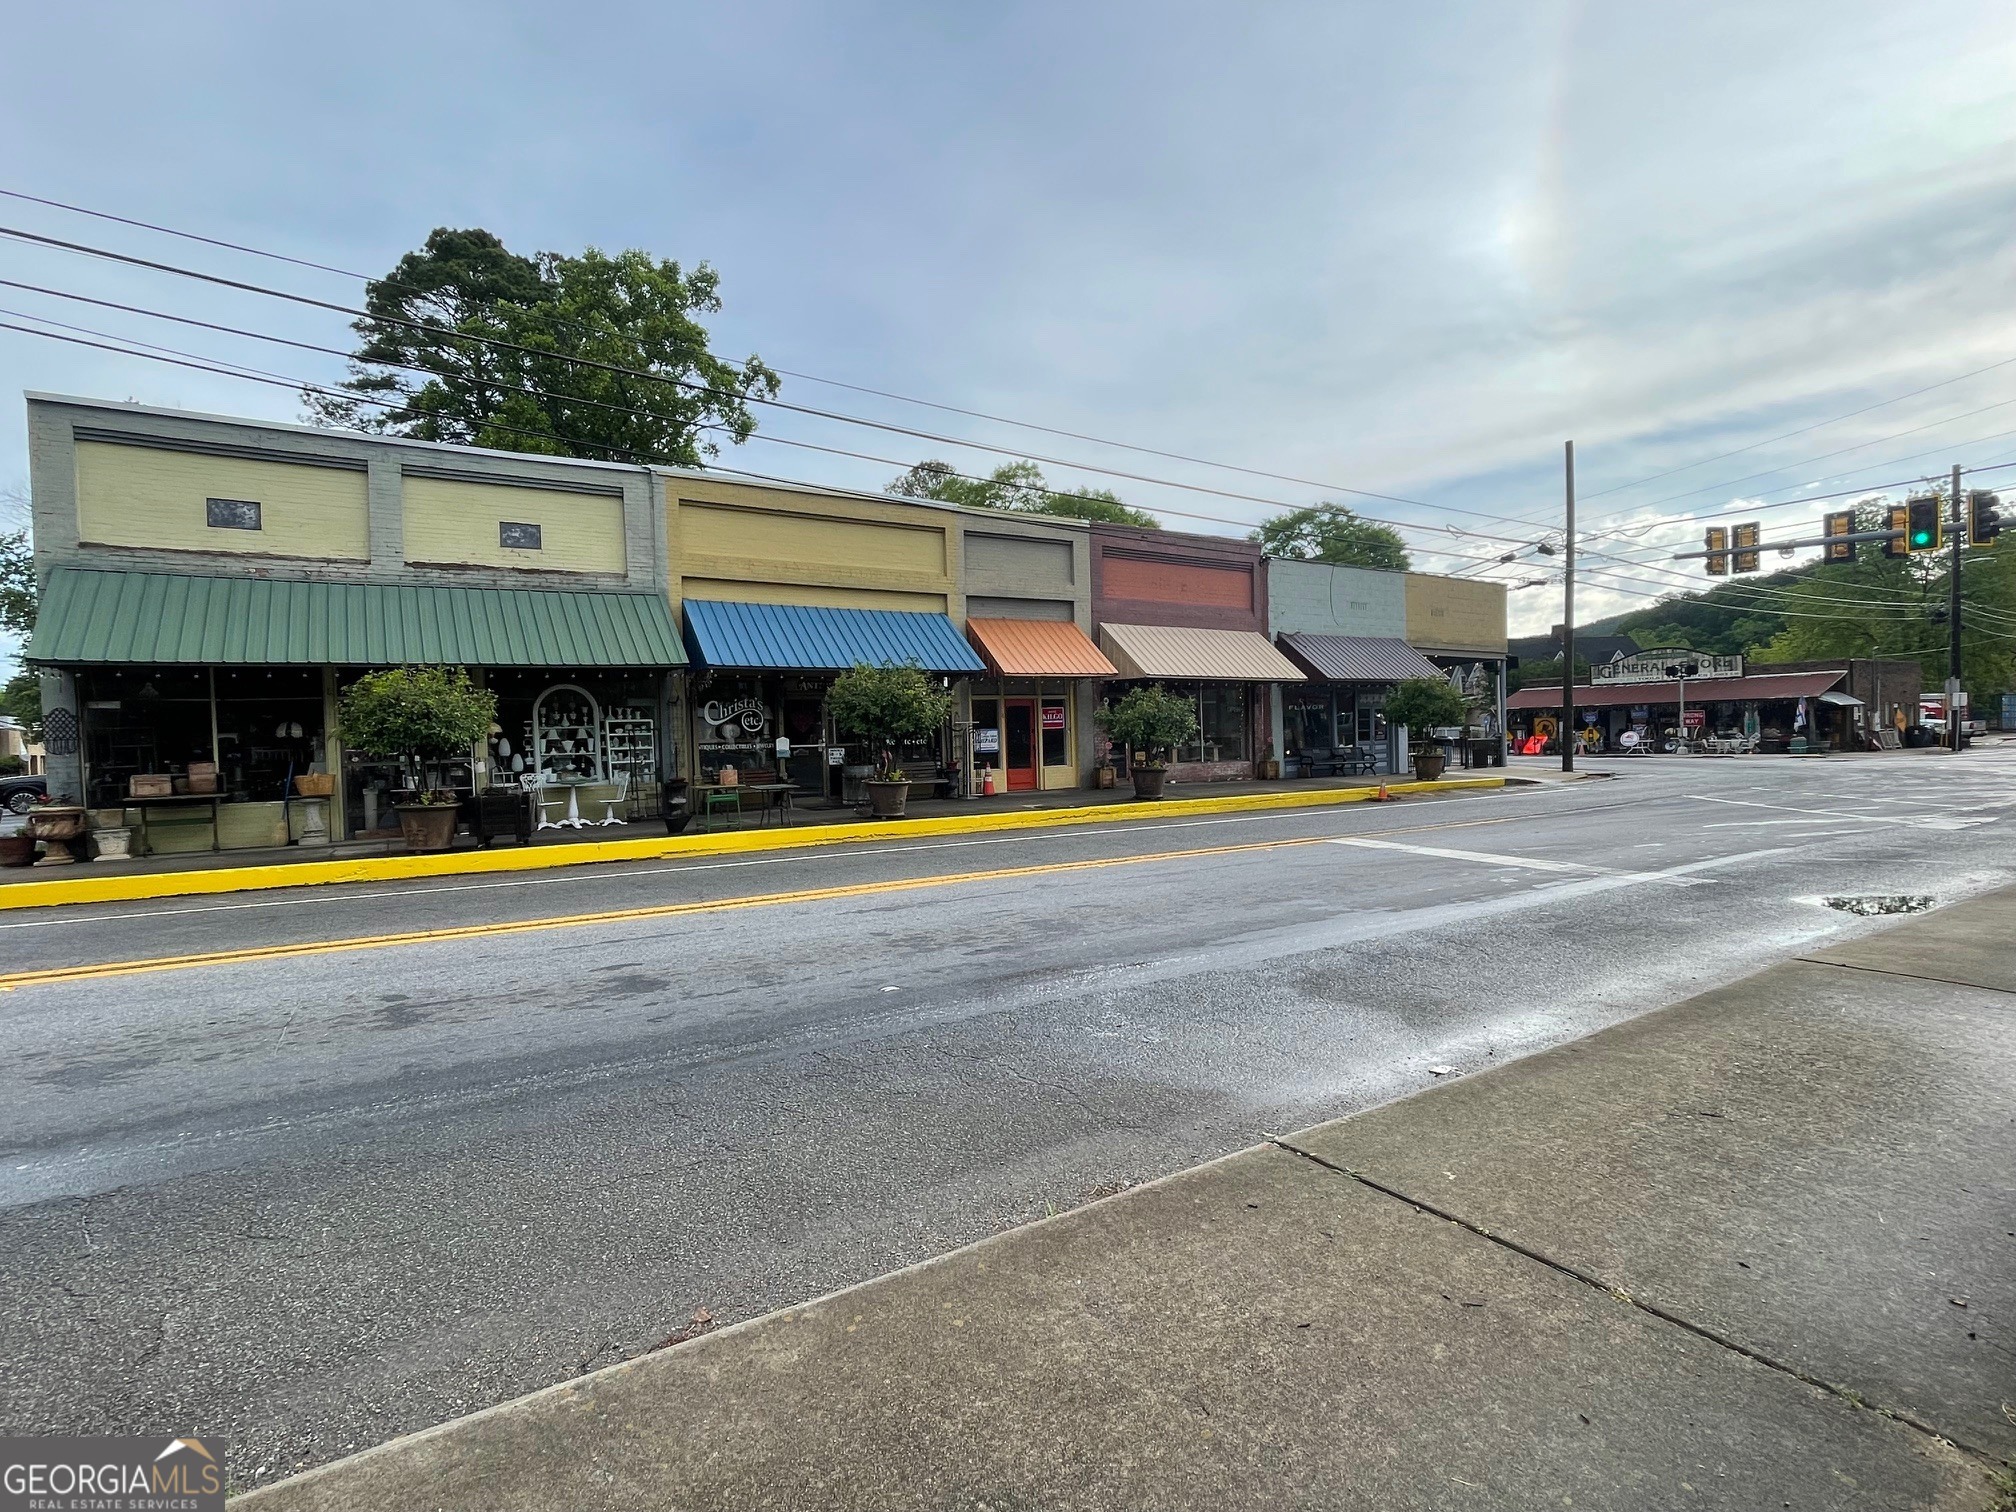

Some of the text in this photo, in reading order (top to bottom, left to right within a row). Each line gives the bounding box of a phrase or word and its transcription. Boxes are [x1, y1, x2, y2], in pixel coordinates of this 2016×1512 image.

[1600, 661, 1667, 678] GENERAL
[1680, 656, 1733, 672] SORE
[704, 696, 763, 726] Christa's
